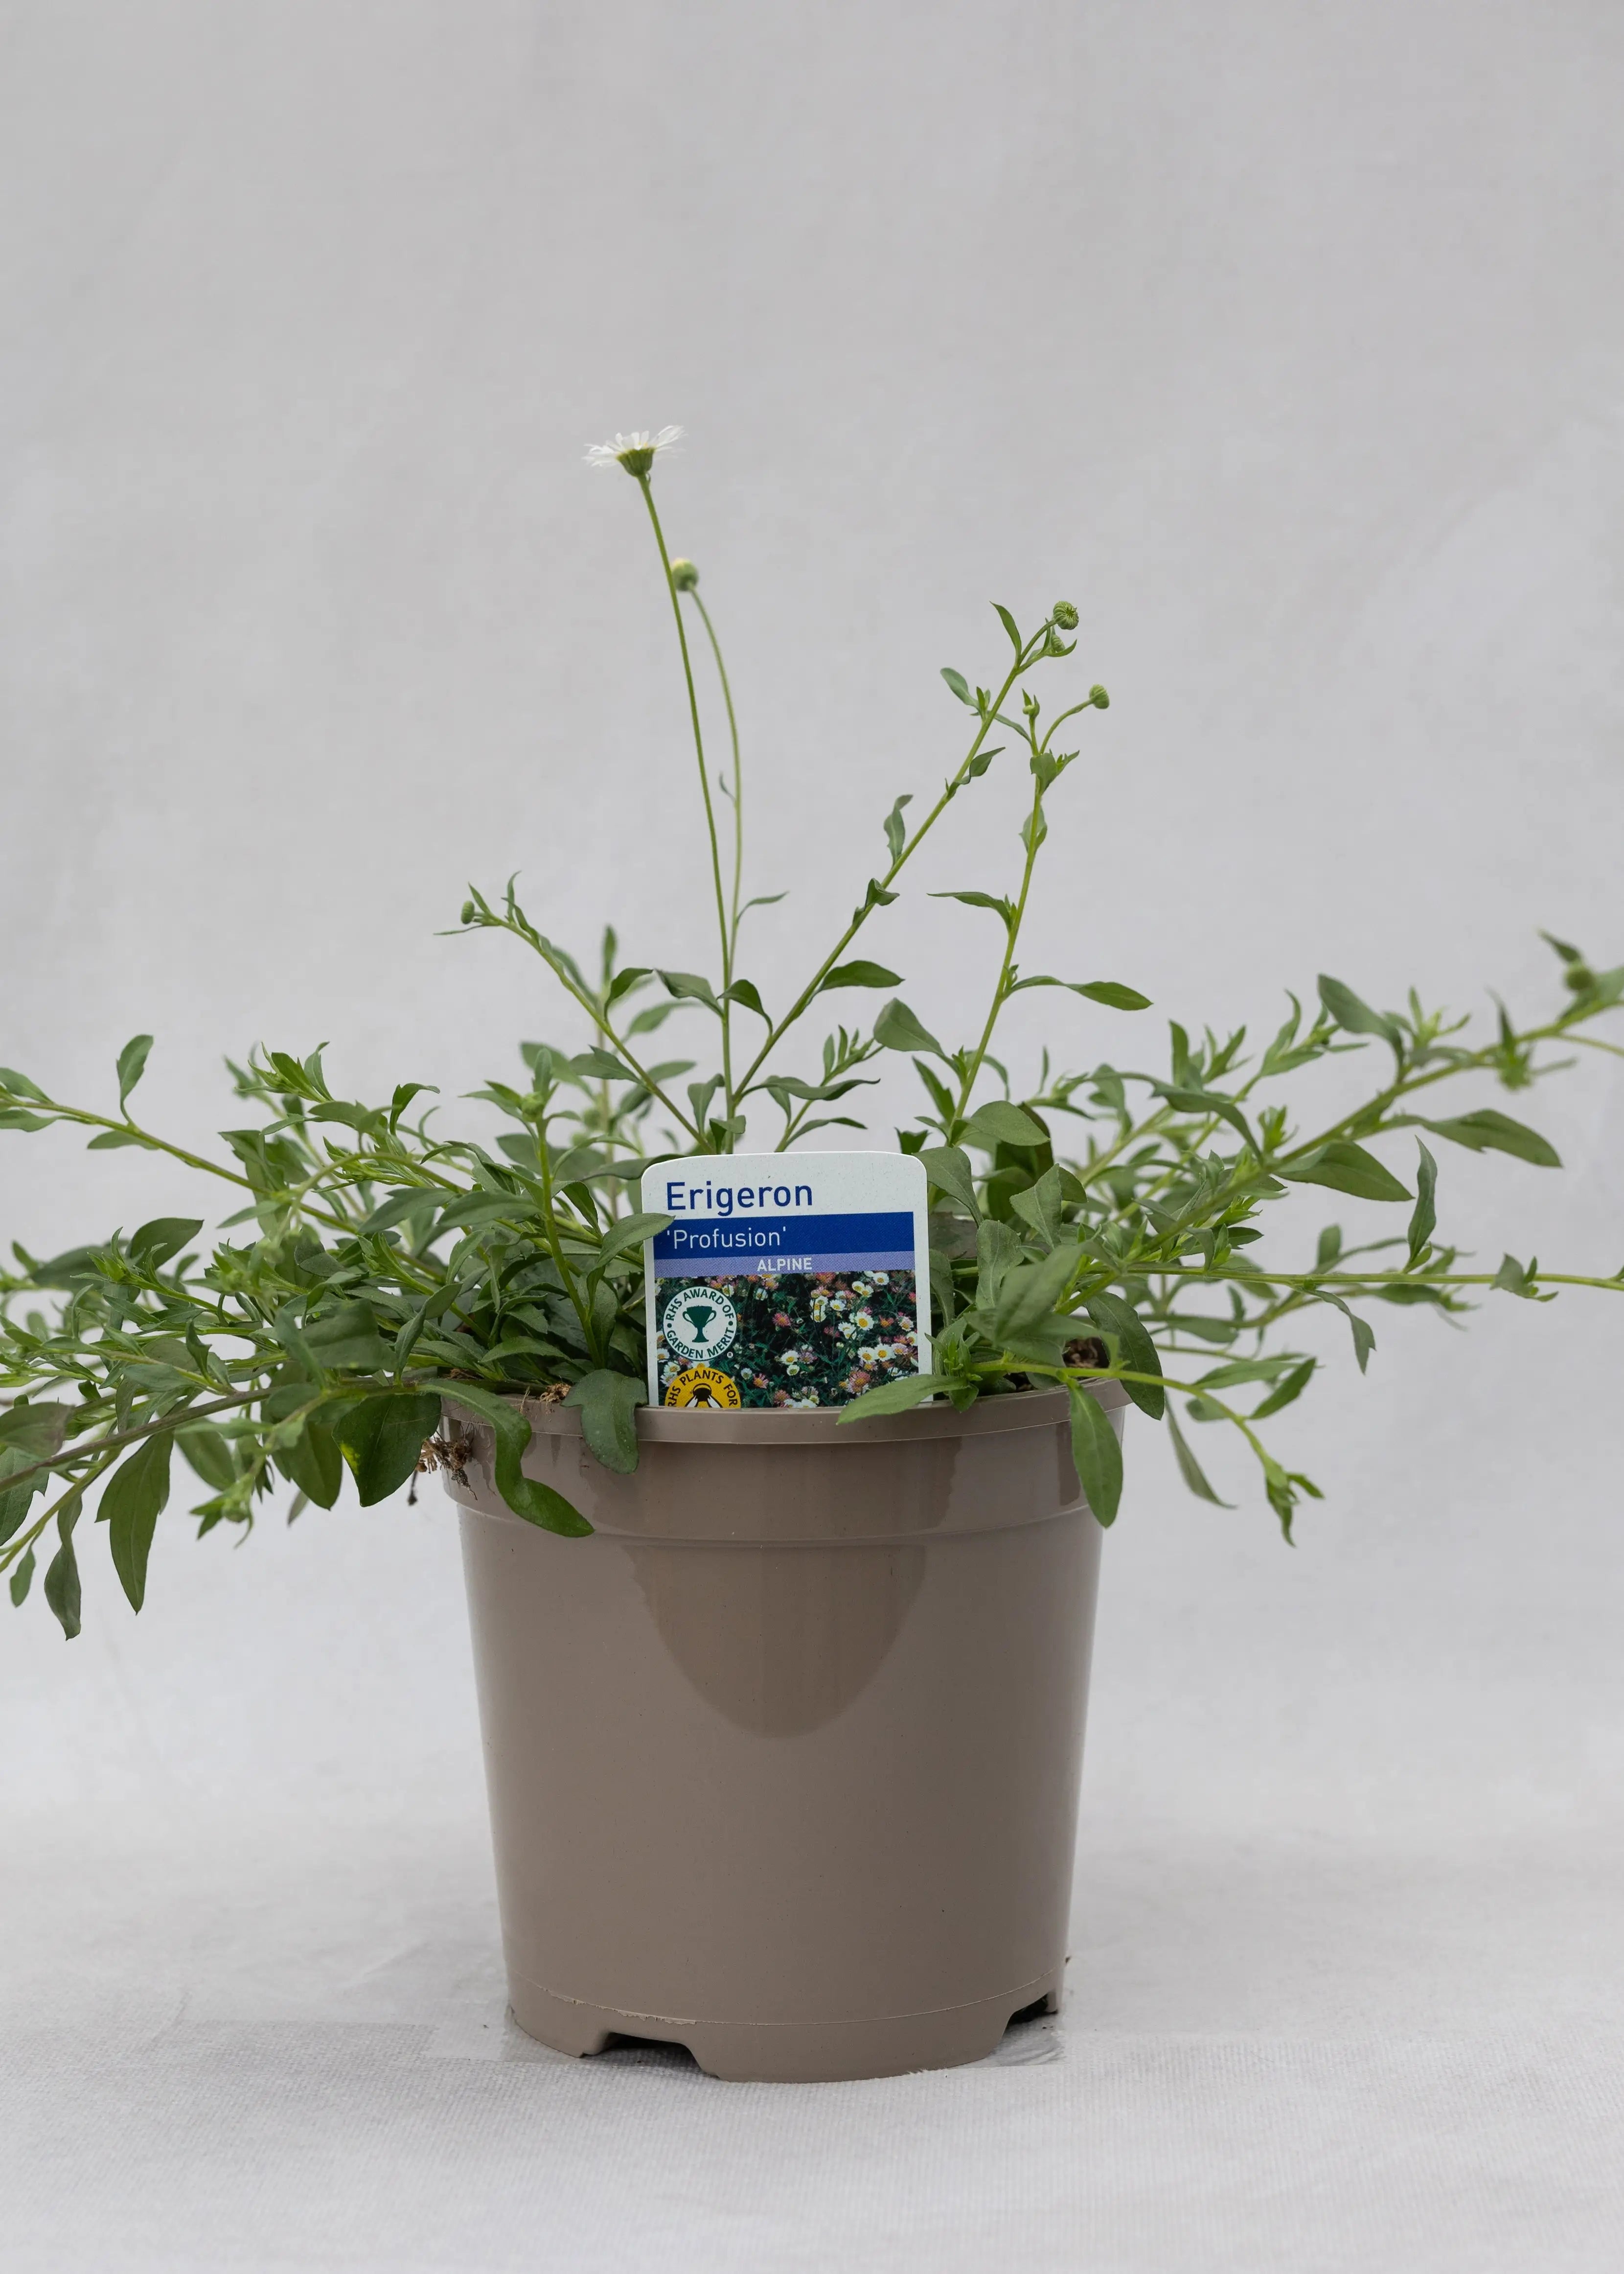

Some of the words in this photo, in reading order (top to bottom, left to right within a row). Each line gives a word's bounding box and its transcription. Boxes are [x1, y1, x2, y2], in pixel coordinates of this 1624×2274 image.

[667, 1181, 812, 1216] Erigeron
[666, 1227, 787, 1250] 'Profusion'
[757, 1257, 812, 1272] ALPINE
[665, 1298, 683, 1321] RHS
[684, 1288, 724, 1305] AWARD
[722, 1304, 734, 1319] OF
[667, 1330, 703, 1359] GARDEN
[707, 1327, 734, 1357] MERIT
[667, 1386, 681, 1407] RHS
[679, 1369, 725, 1386] PLANTS
[723, 1383, 738, 1406] FOR
